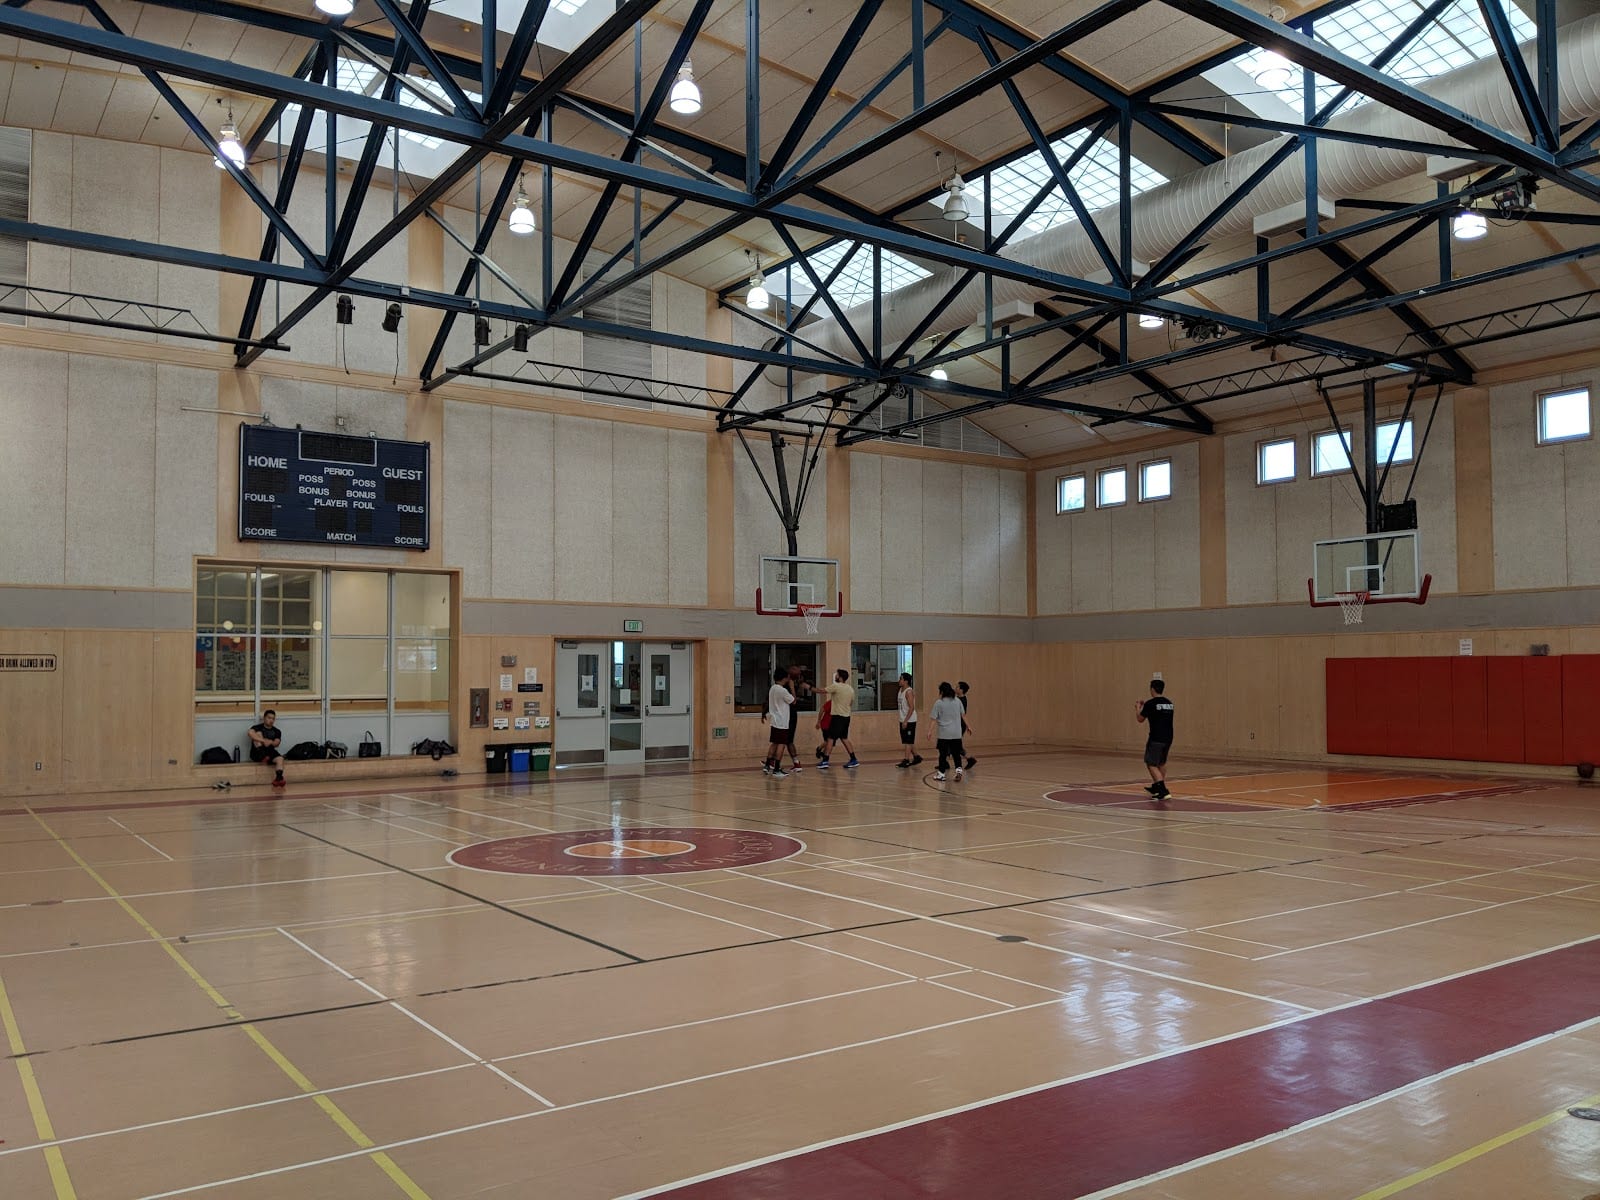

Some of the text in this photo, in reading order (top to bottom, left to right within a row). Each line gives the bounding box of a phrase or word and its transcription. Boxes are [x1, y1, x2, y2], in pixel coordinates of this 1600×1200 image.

[247, 455, 288, 470] HOME
[323, 466, 354, 477] PERIOD
[382, 467, 423, 481] GUEST
[298, 474, 324, 484] POSS
[352, 478, 377, 488] POSS
[298, 486, 330, 496] BONUS
[346, 489, 377, 500] BONUS
[244, 493, 275, 503] FOULS
[314, 497, 375, 510] PLAYER FOUL
[397, 503, 424, 514] FOULS
[244, 527, 277, 537] SCORE
[326, 532, 356, 542] MATCH
[394, 536, 424, 546] SCORE
